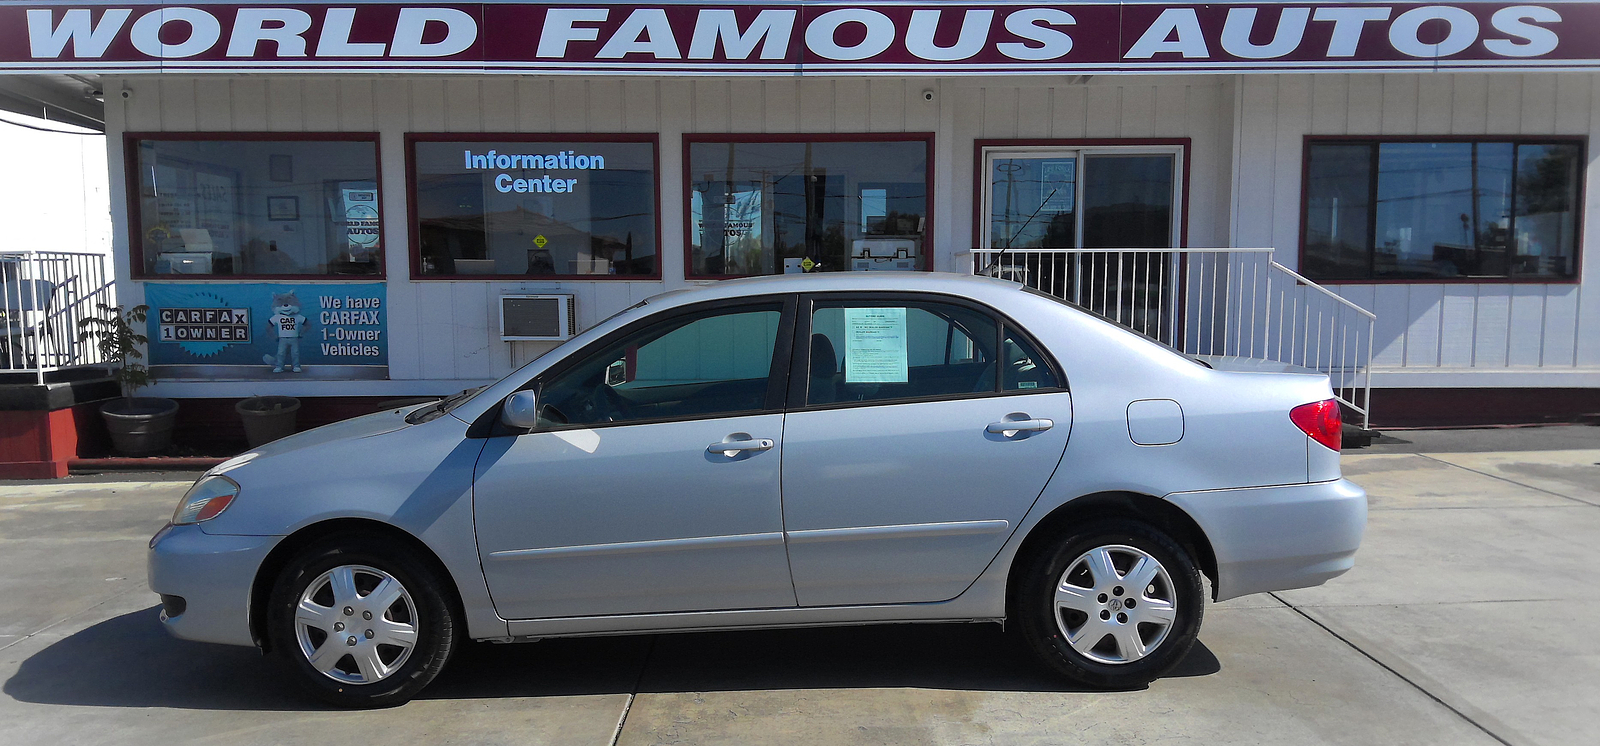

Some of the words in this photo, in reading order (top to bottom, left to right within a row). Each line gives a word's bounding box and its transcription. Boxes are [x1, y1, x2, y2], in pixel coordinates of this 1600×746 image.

[26, 7, 478, 58] WORLD
[536, 8, 1076, 60] FAMOUS
[1123, 6, 1562, 58] AUTOS
[464, 150, 605, 170] Information
[494, 173, 577, 193] Center
[319, 296, 342, 309] We
[346, 296, 380, 309] have
[162, 311, 245, 324] CARFAX
[320, 310, 380, 325] CARFAX
[321, 327, 380, 340] 1-Owner
[321, 343, 380, 356] Vehicles
